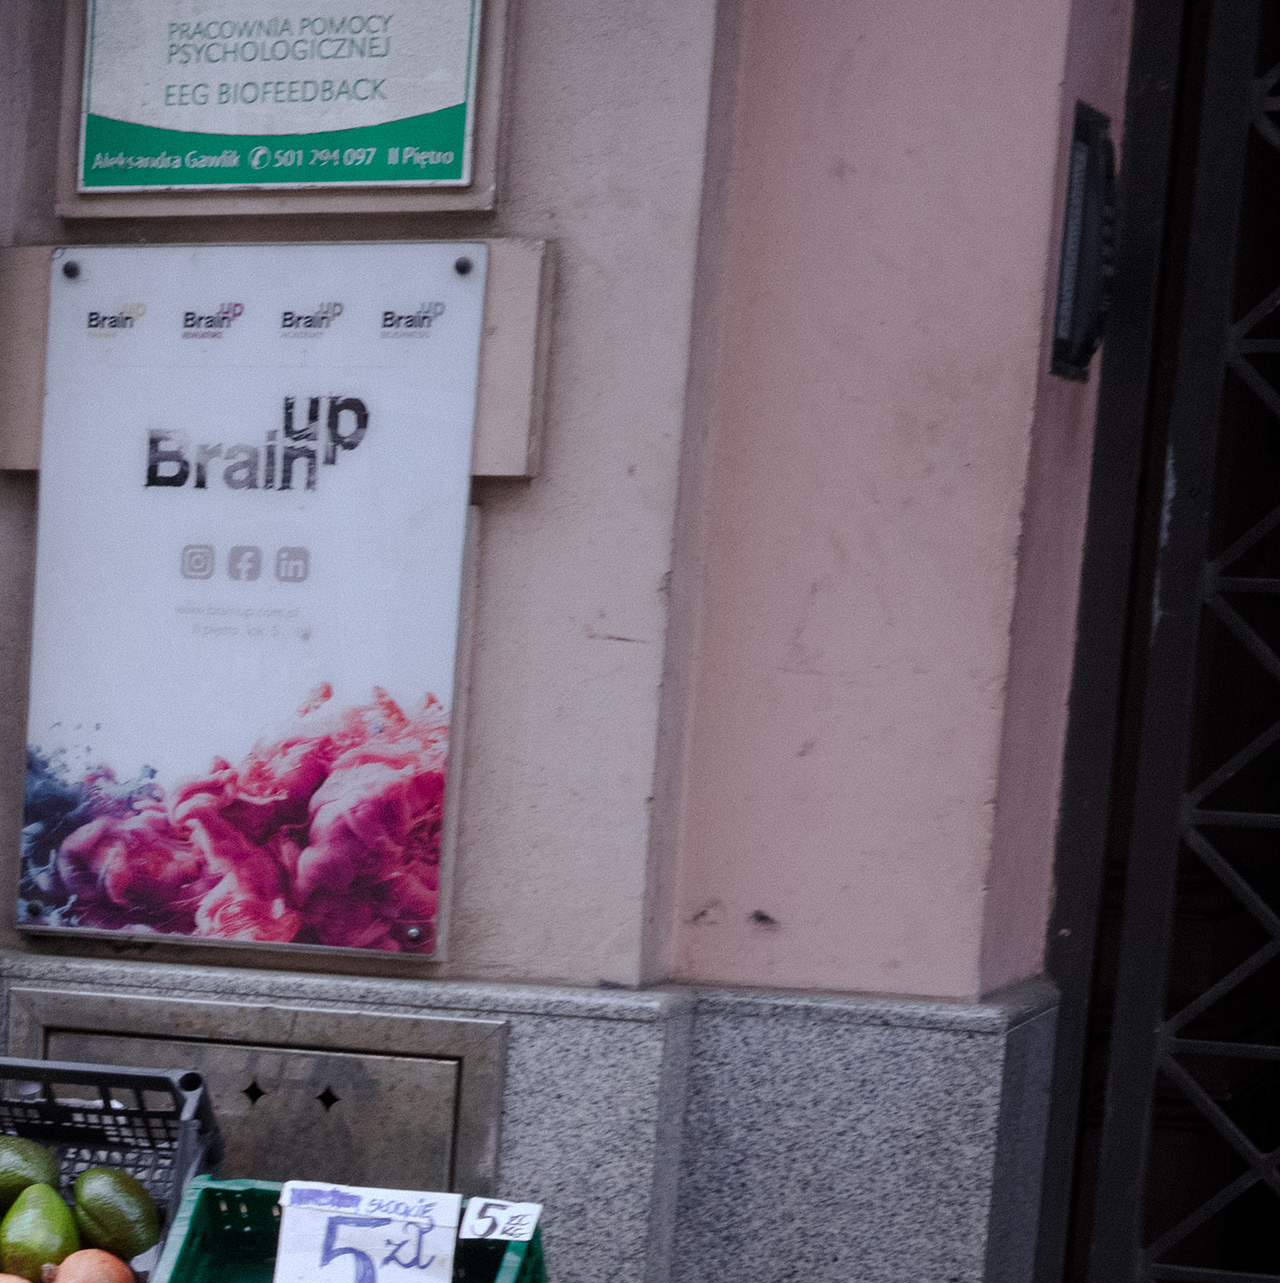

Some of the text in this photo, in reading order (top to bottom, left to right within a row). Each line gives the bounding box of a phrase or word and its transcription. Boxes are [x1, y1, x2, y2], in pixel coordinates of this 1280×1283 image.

[167, 14, 395, 41] PRACOWNIA POMOCY
[166, 37, 392, 65] PSYCHOLOGICZNEJ
[163, 78, 389, 107] EEG BIOFEEDBACK
[272, 149, 304, 168] 501
[342, 147, 378, 167] 097
[87, 311, 134, 329] Brain
[182, 311, 231, 329] Brain
[280, 311, 331, 329] Brain
[381, 311, 432, 329] Brain
[144, 394, 370, 491] Brain up
[468, 1201, 509, 1239] 5
[381, 1216, 437, 1270] zł
